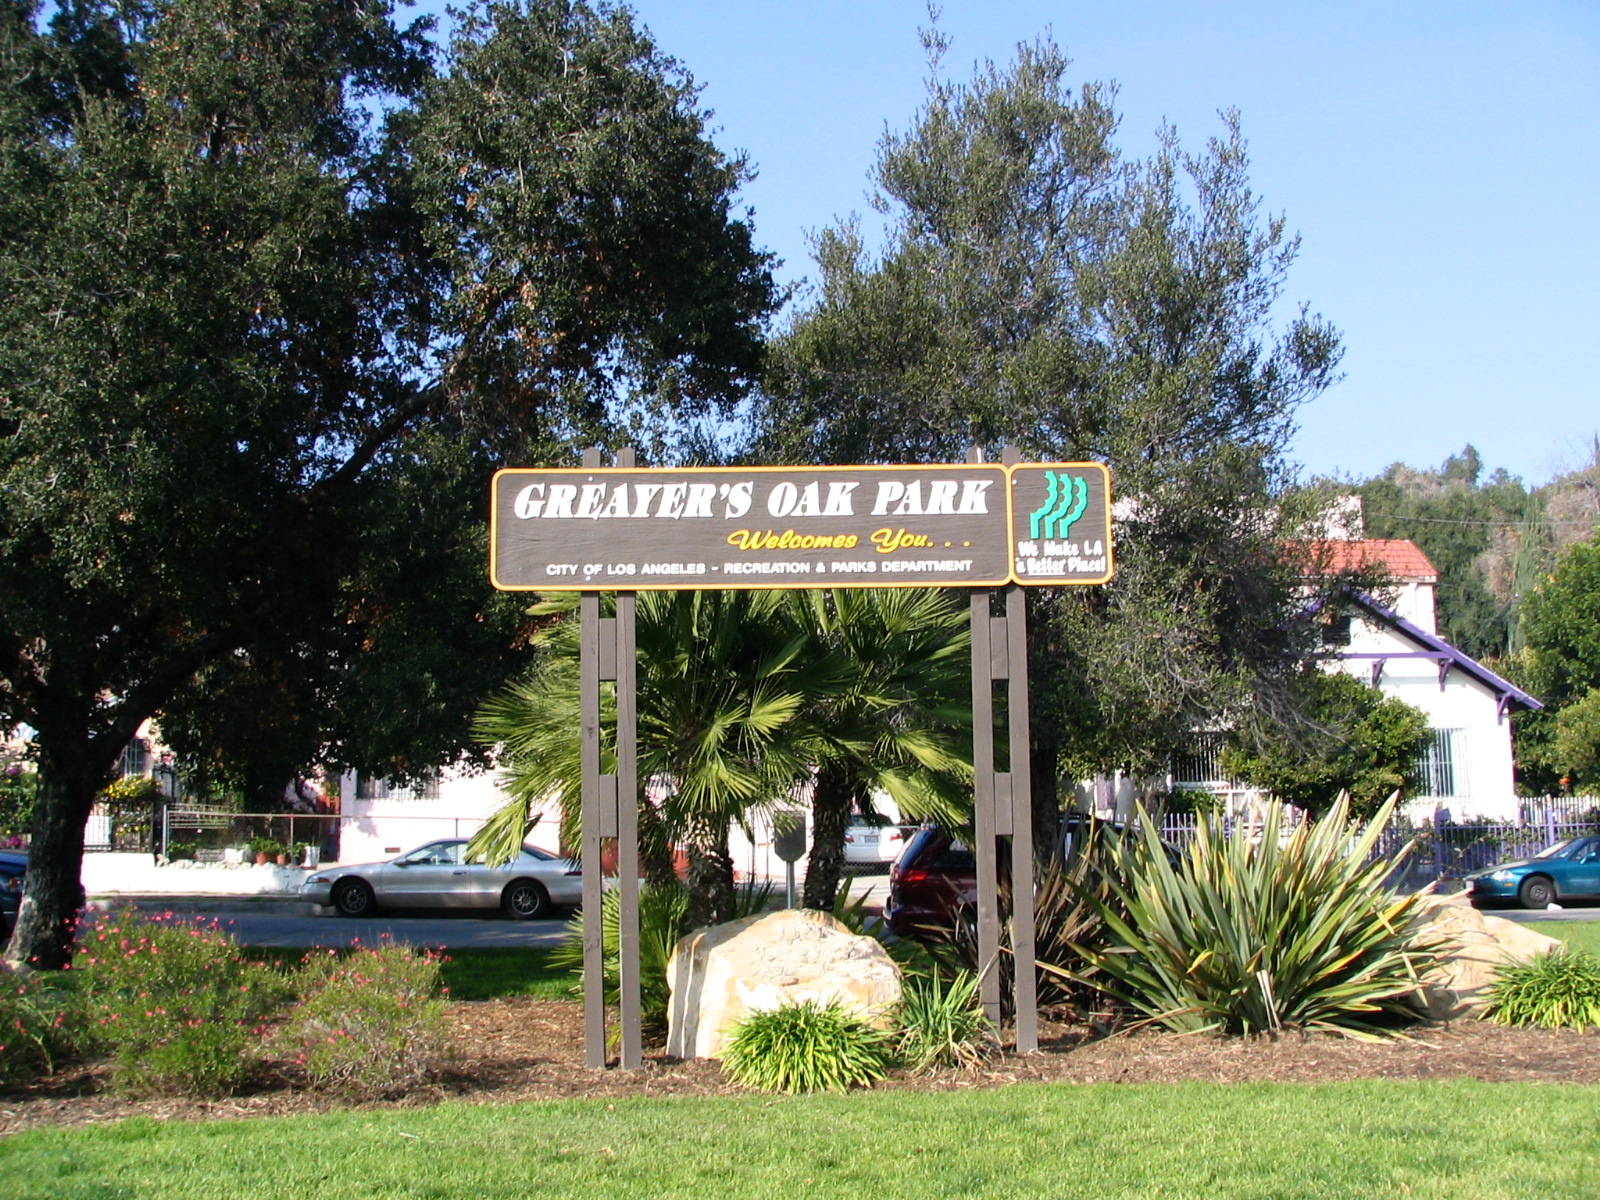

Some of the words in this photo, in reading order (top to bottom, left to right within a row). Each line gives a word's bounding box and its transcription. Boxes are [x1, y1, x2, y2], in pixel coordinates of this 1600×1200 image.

[514, 481, 754, 520] GREAYER'S
[767, 481, 860, 517] OAK
[870, 479, 994, 515] PARK
[727, 529, 859, 550] Welcomes
[1018, 541, 1039, 556] We
[1044, 540, 1080, 556] Make
[546, 564, 578, 575] CITY
[583, 564, 602, 575] OF
[607, 564, 636, 575] LOS
[641, 563, 706, 575] ANGELES
[724, 562, 810, 574] RECREATION
[815, 562, 826, 573] &
[831, 561, 877, 573] PARKS
[881, 560, 973, 572] DEPARTMENT
[1016, 562, 1026, 573] a
[1027, 557, 1066, 574] Better
